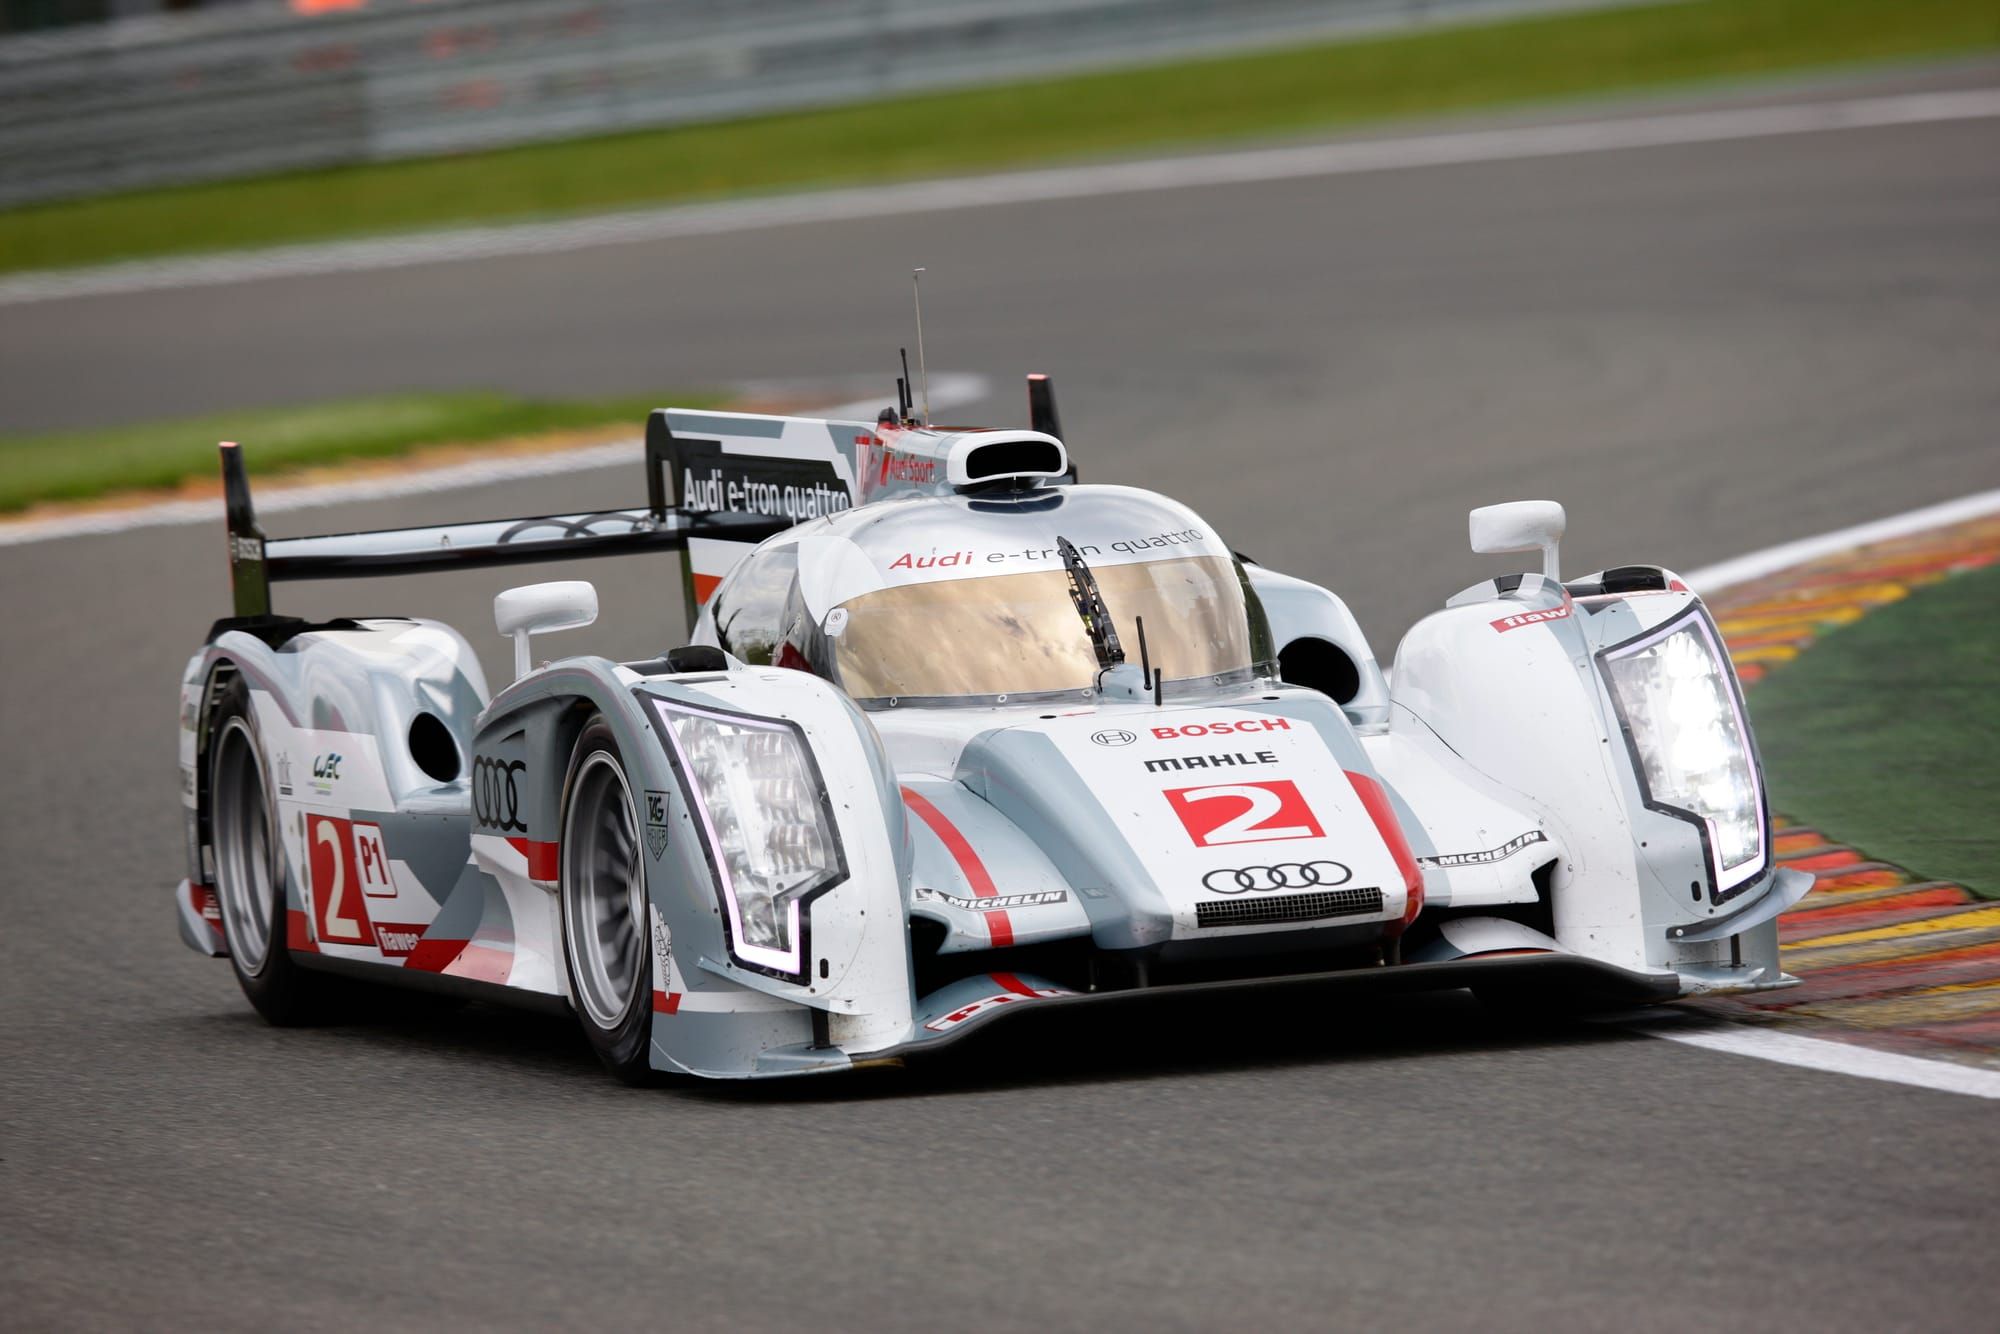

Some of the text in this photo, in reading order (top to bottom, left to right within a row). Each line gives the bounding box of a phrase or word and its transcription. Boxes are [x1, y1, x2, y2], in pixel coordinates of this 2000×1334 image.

[684, 467, 849, 527] Audi e-tron quattro
[889, 551, 973, 570] Audi
[1111, 526, 1204, 555] quattro
[1150, 718, 1291, 740] BOSCH
[1144, 750, 1279, 773] MAHLE
[1182, 785, 1313, 845] 2
[359, 835, 388, 885] P1
[1439, 831, 1540, 865] MICHELIN
[316, 820, 362, 939] 2
[948, 891, 1063, 909] MICHELIN
